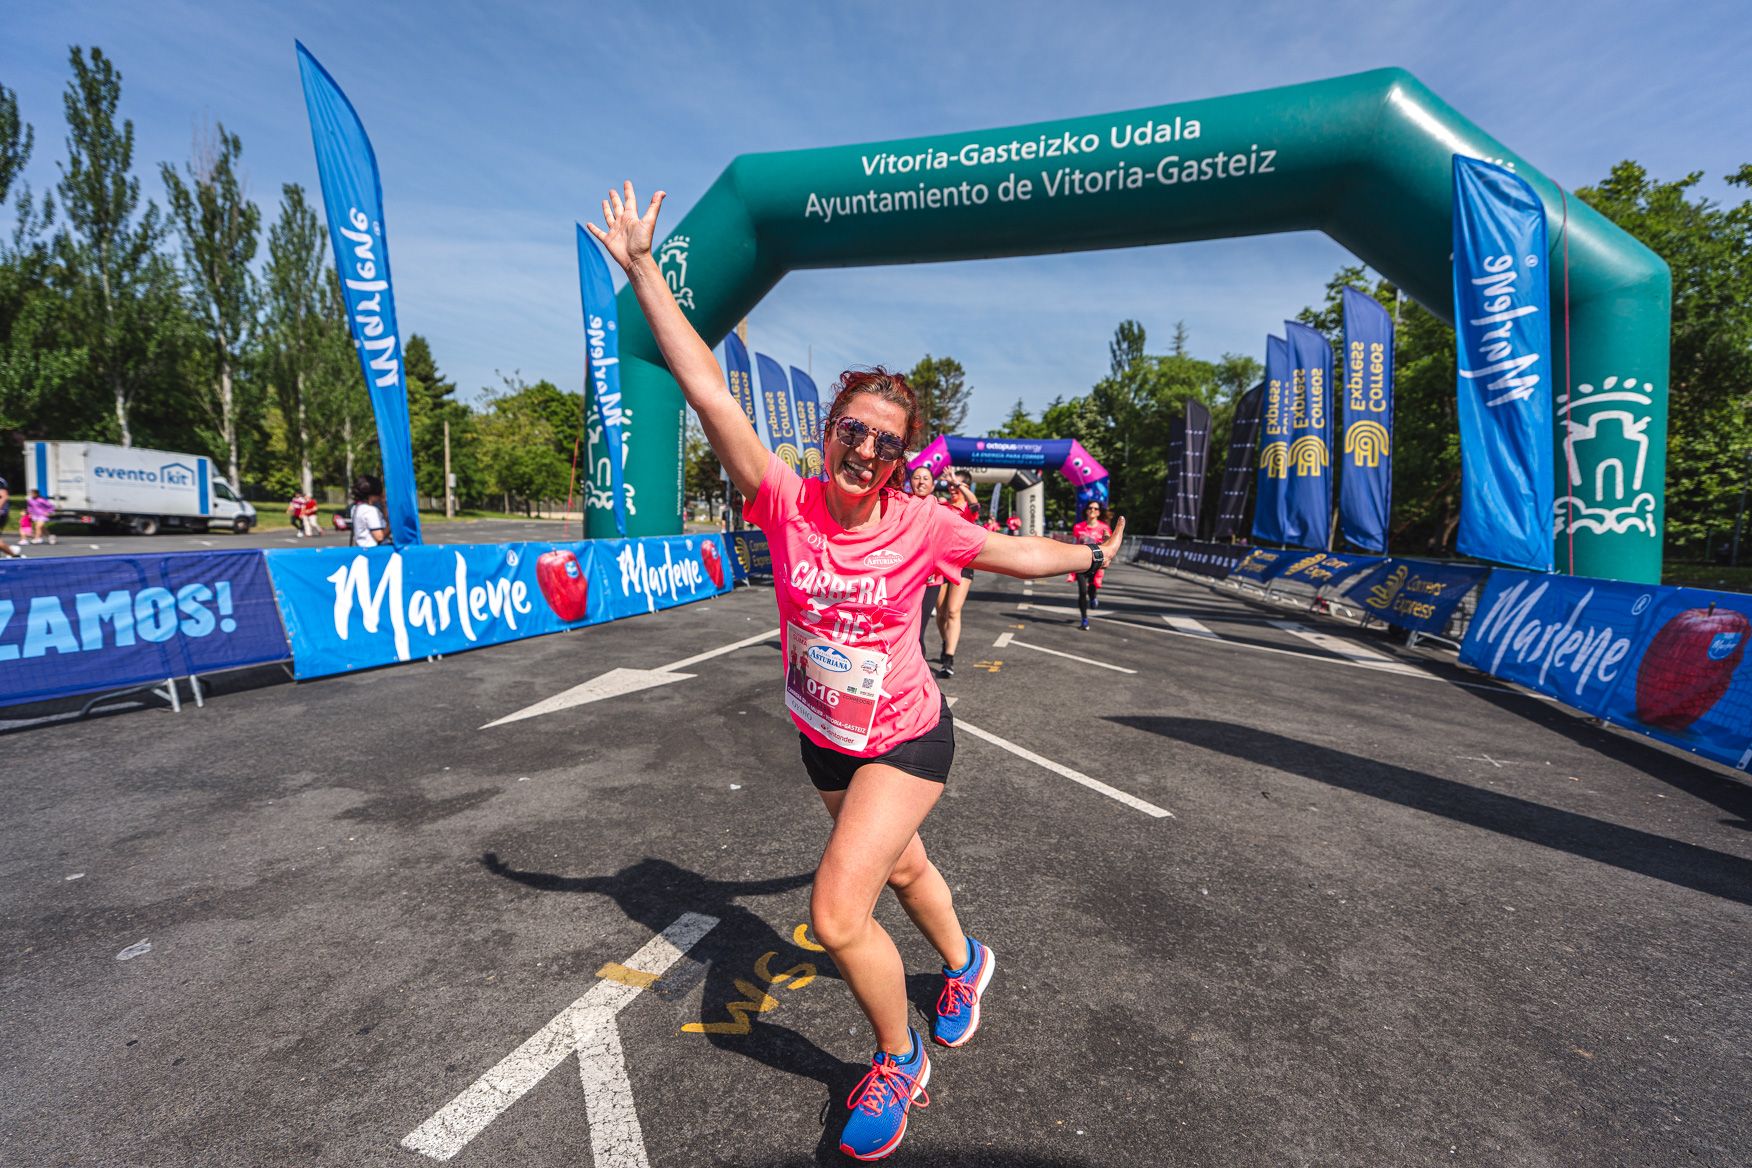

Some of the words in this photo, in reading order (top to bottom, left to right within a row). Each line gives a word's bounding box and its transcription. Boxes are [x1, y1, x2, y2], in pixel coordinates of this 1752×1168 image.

[861, 131, 1101, 177] Vitoria-Gasteizko
[1110, 115, 1202, 148] Udala
[804, 180, 989, 223] Ayuntamiento
[997, 172, 1032, 202] de
[1038, 145, 1277, 199] Vitoria-Gasteiz
[94, 465, 158, 483] evento
[167, 470, 189, 486] kit
[328, 550, 532, 661] Marlene
[617, 541, 703, 612] Marlene
[791, 560, 889, 606] CARRERA
[810, 650, 849, 671] ASTURIANA
[1475, 579, 1631, 696] Marlene
[806, 678, 841, 707] 016
